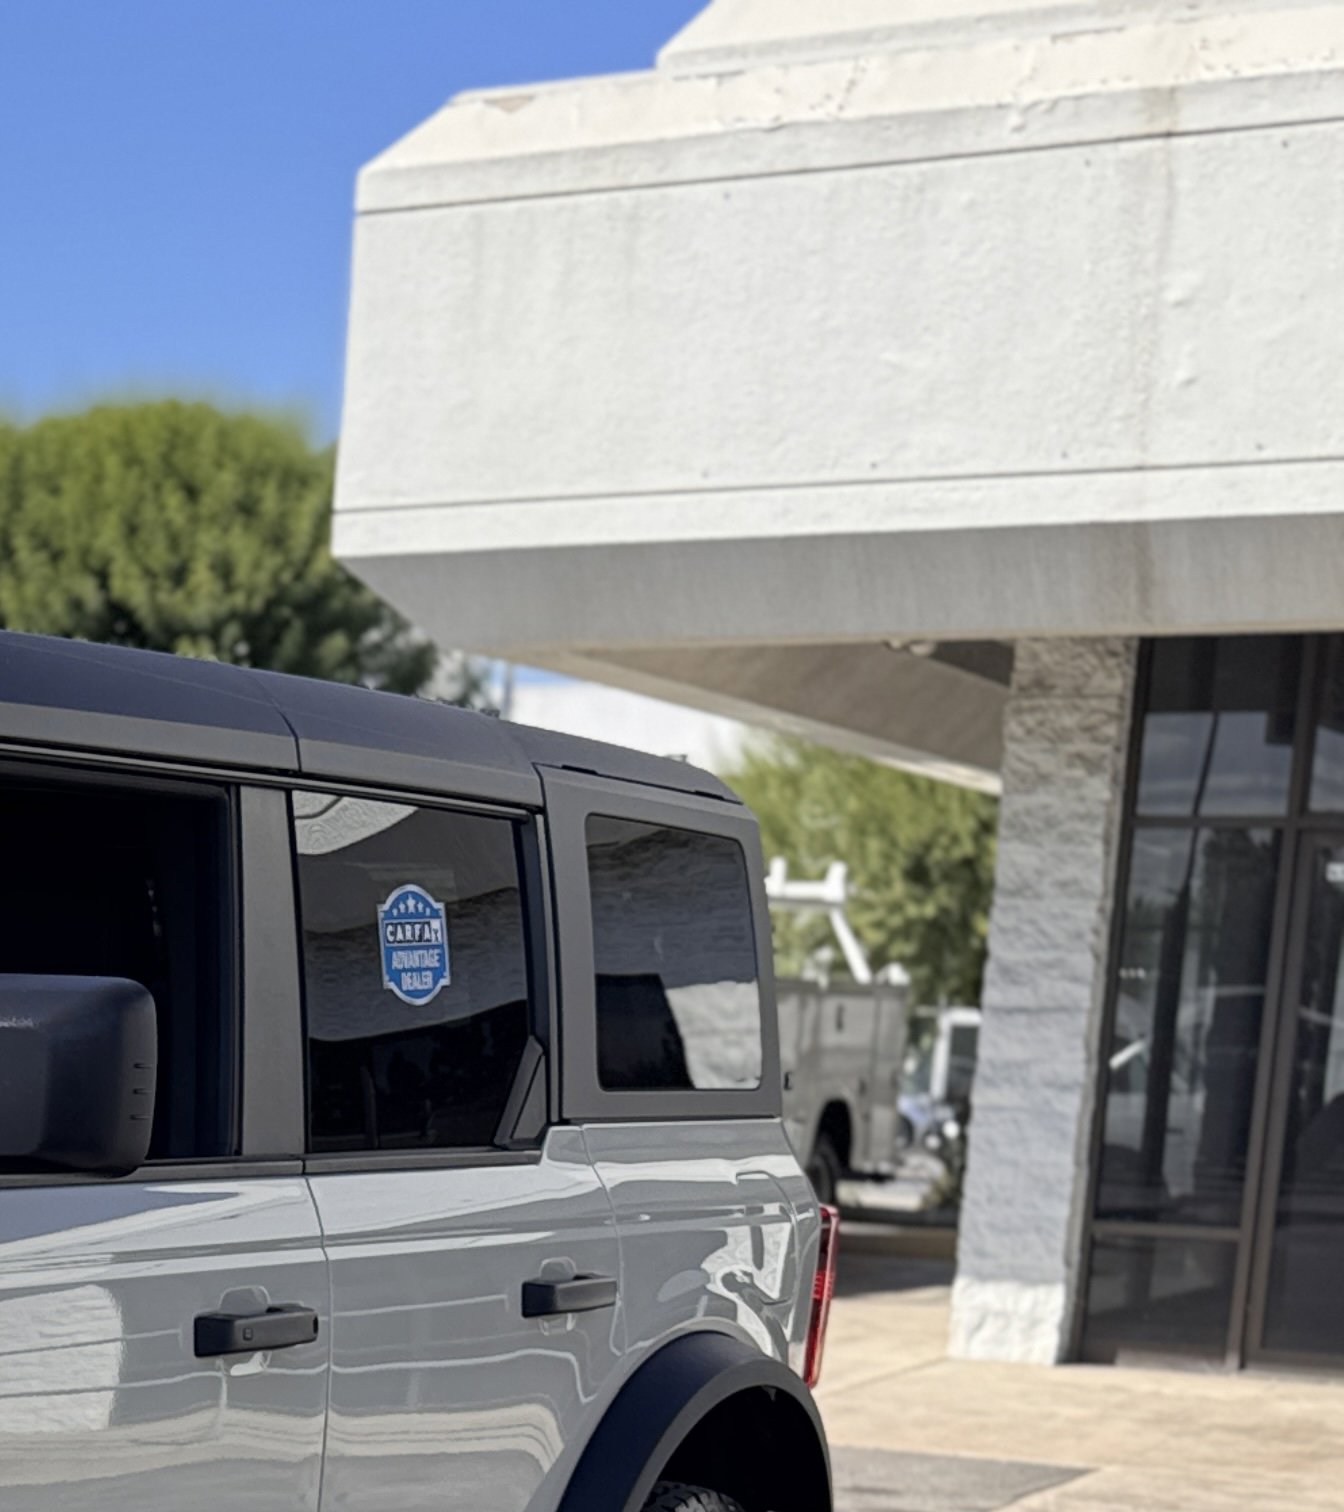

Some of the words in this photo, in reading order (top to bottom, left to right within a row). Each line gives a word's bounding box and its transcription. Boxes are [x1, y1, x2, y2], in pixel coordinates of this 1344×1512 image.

[385, 921, 442, 944] CARFAX
[392, 949, 441, 970] ADVANTAGE
[401, 970, 433, 991] DEALER
